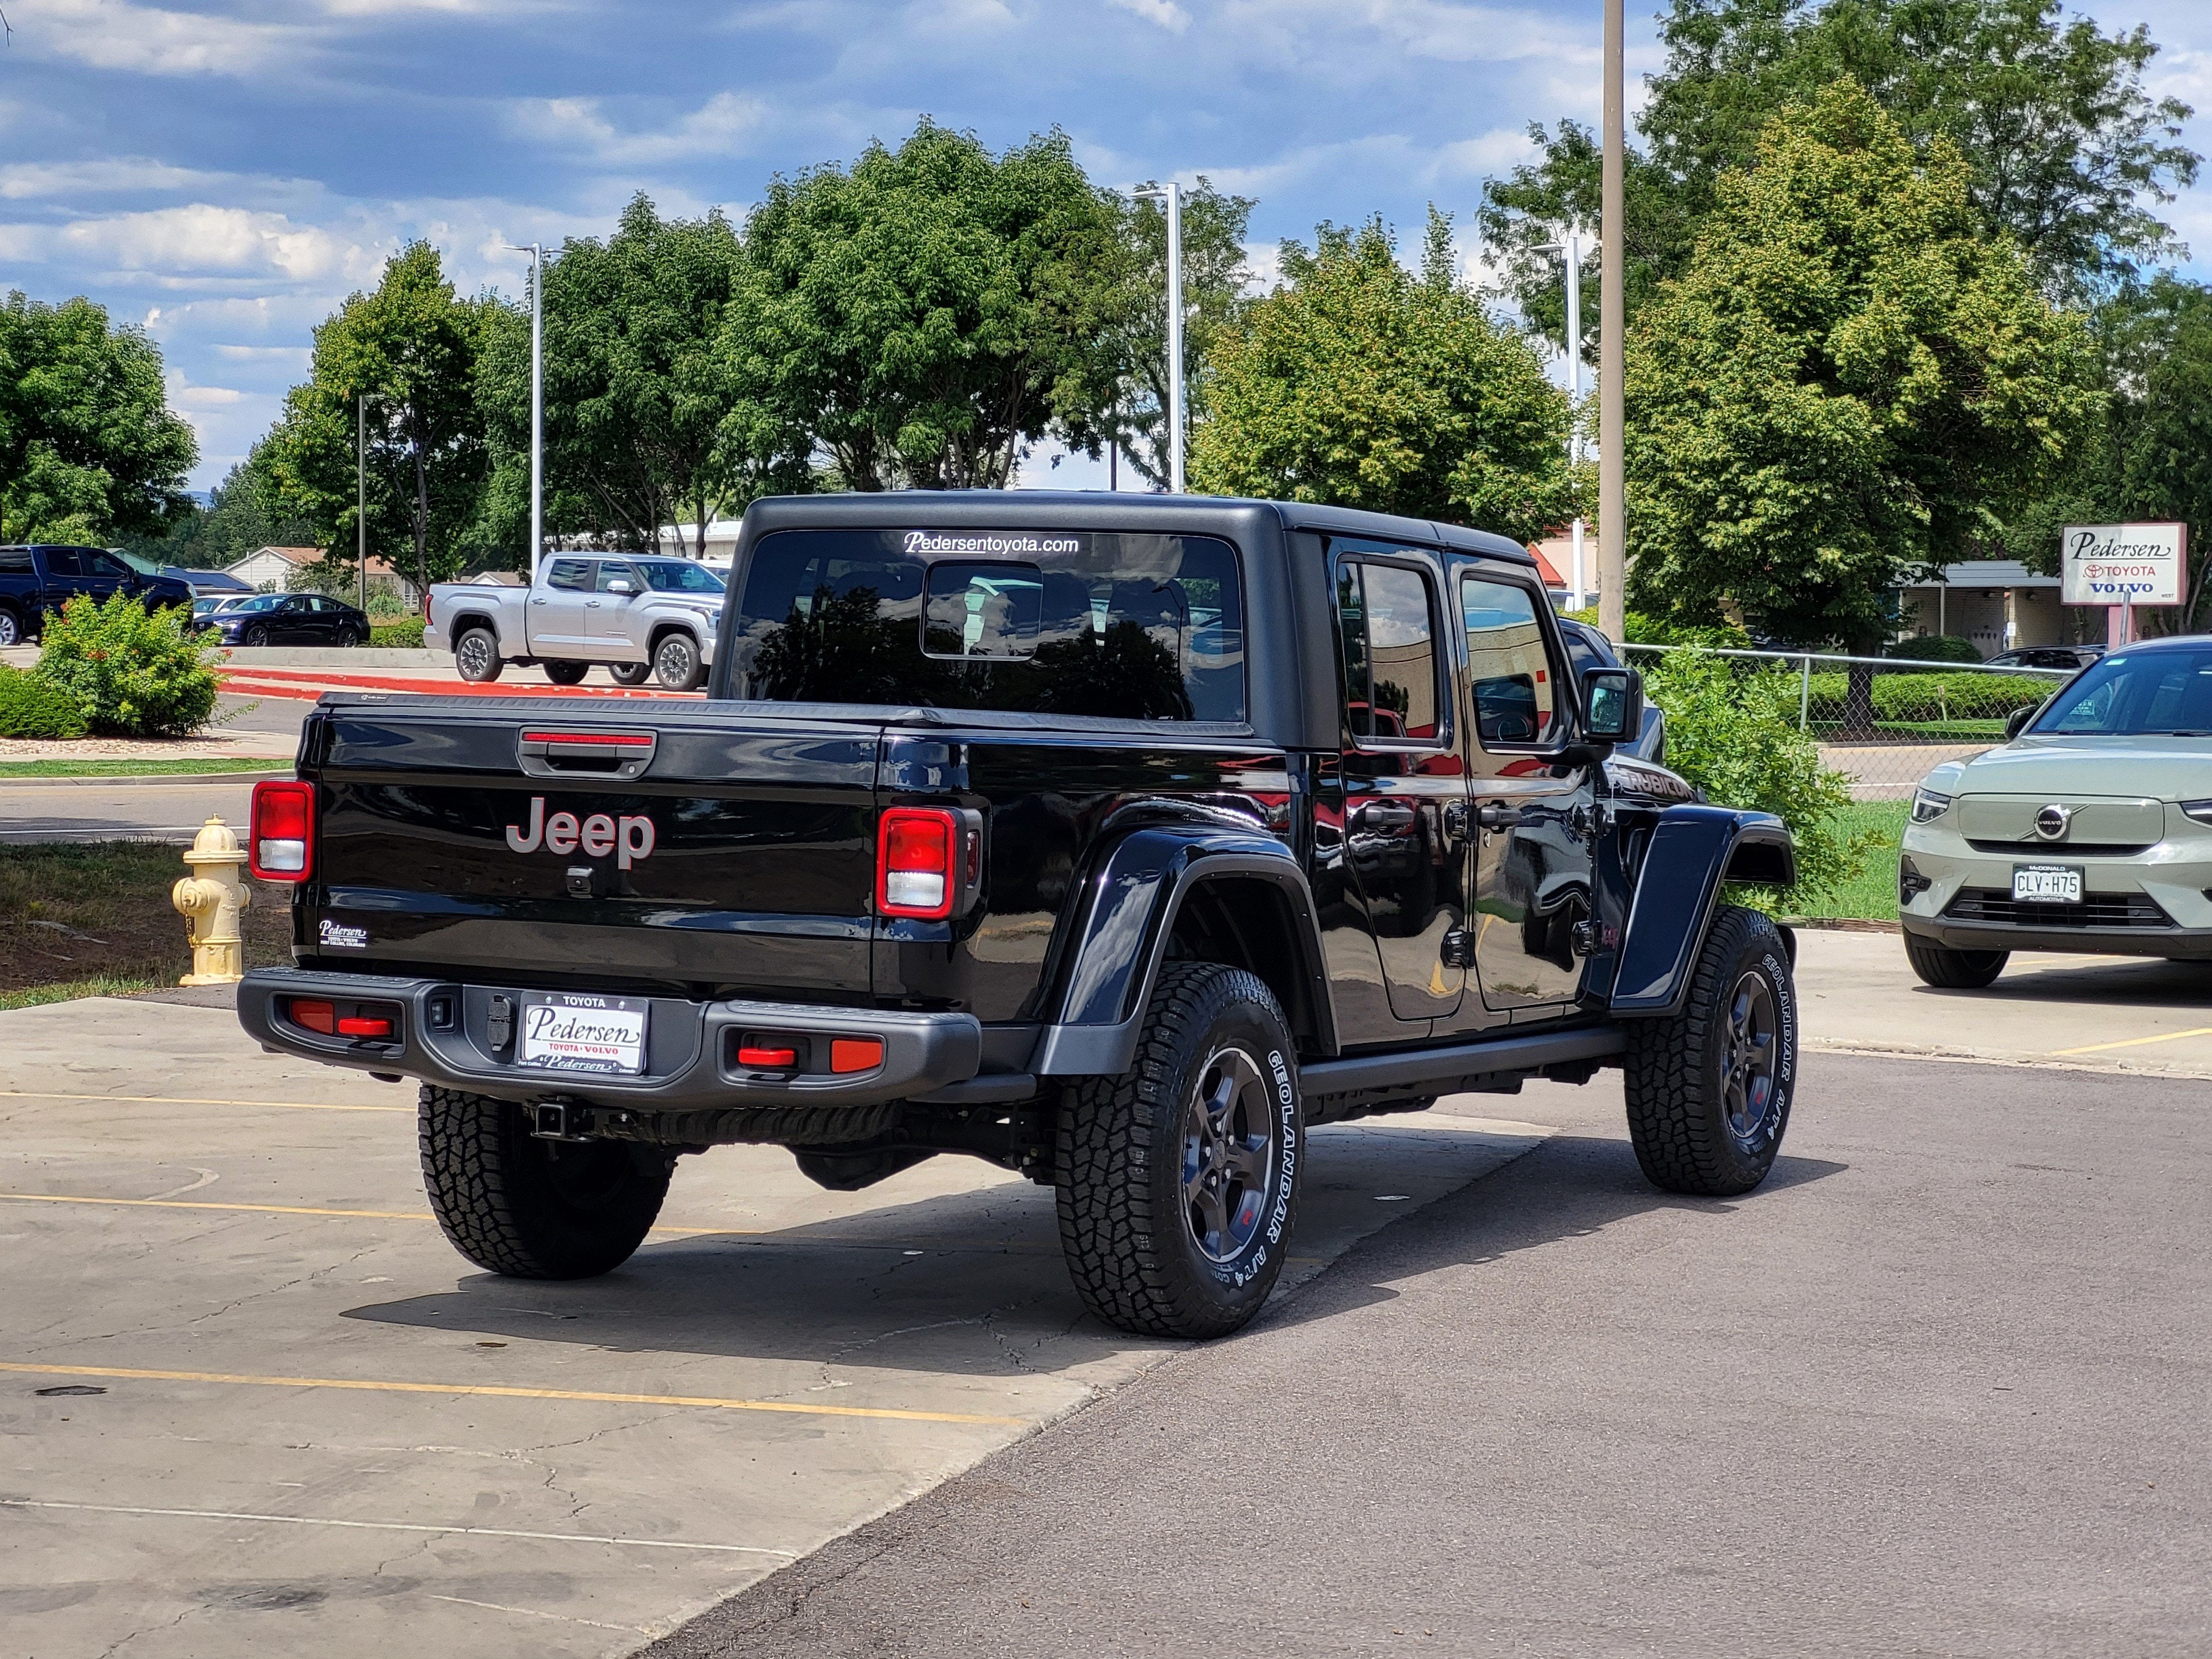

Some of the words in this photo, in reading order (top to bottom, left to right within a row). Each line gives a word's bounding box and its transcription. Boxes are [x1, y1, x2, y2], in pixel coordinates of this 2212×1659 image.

[904, 531, 1078, 555] Pedersentoyota.com
[2070, 532, 2171, 560] Pedersen
[2105, 566, 2156, 576] TOYOTA
[2089, 583, 2153, 593] VOLVO
[506, 797, 655, 870] Jeep
[319, 920, 367, 937] Pedersen
[563, 996, 606, 1008] TOYOTA
[528, 1008, 640, 1043] Pedersen
[1762, 953, 1792, 1081] GEOLANDAR
[549, 1043, 579, 1052] TOYOTA
[585, 1046, 619, 1055] VOLVO
[544, 1053, 612, 1071] Pedersen
[1267, 1050, 1295, 1244] GEOLANDAR
